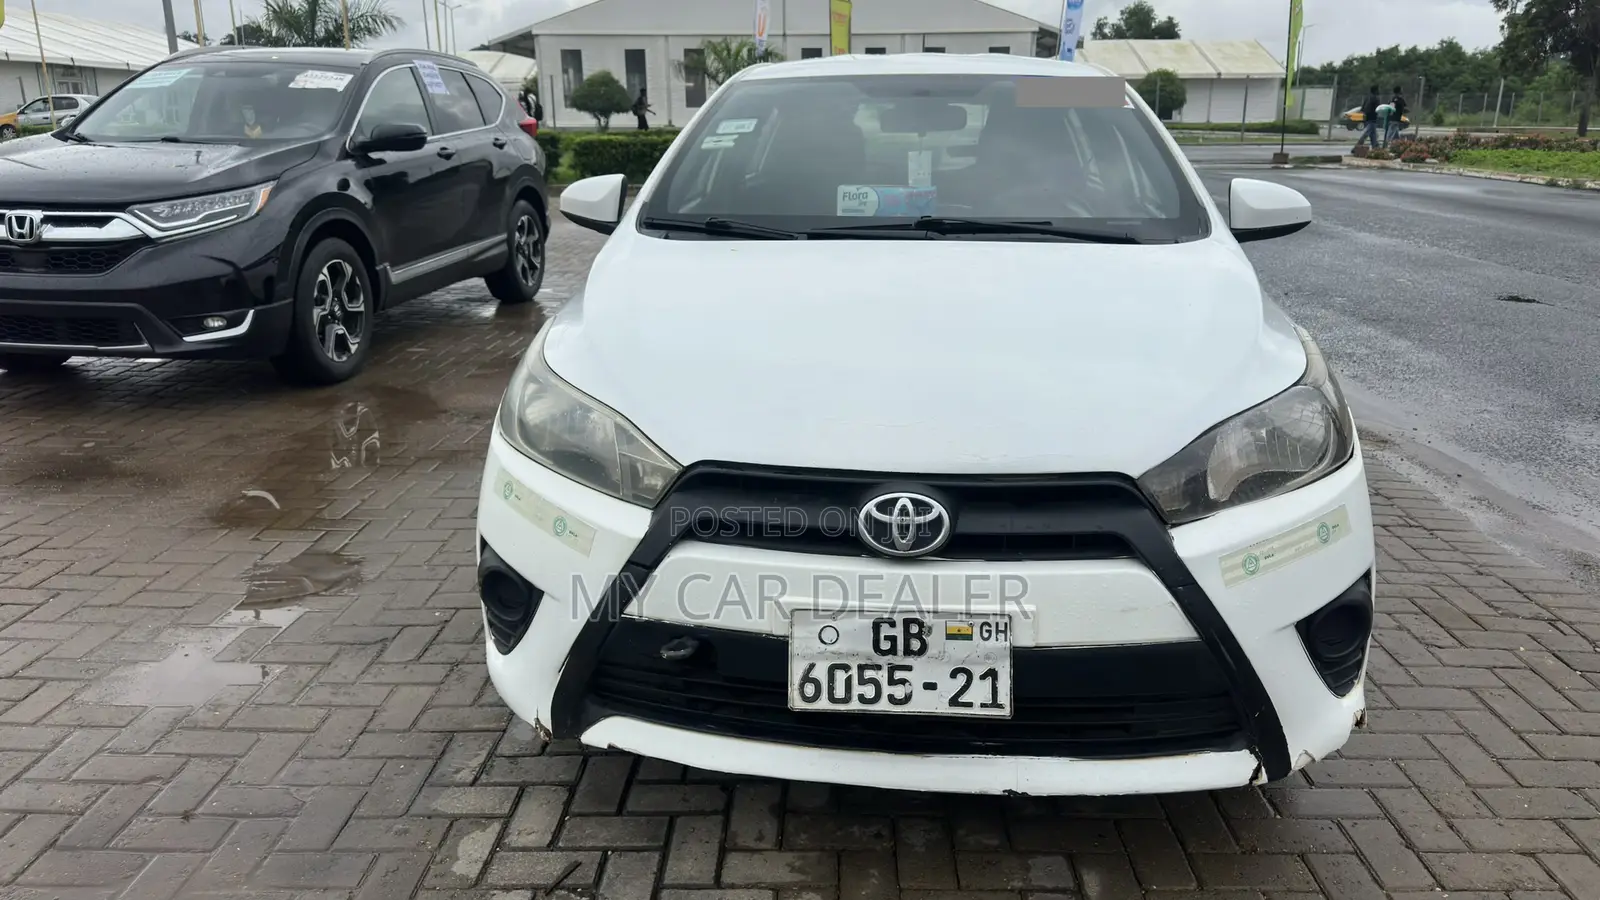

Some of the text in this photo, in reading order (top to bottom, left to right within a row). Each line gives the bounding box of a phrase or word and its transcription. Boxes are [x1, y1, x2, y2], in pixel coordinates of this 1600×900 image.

[842, 191, 869, 202] Flora
[872, 617, 929, 657] GB
[979, 621, 1008, 642] GH
[799, 662, 1005, 709] 6055-21
